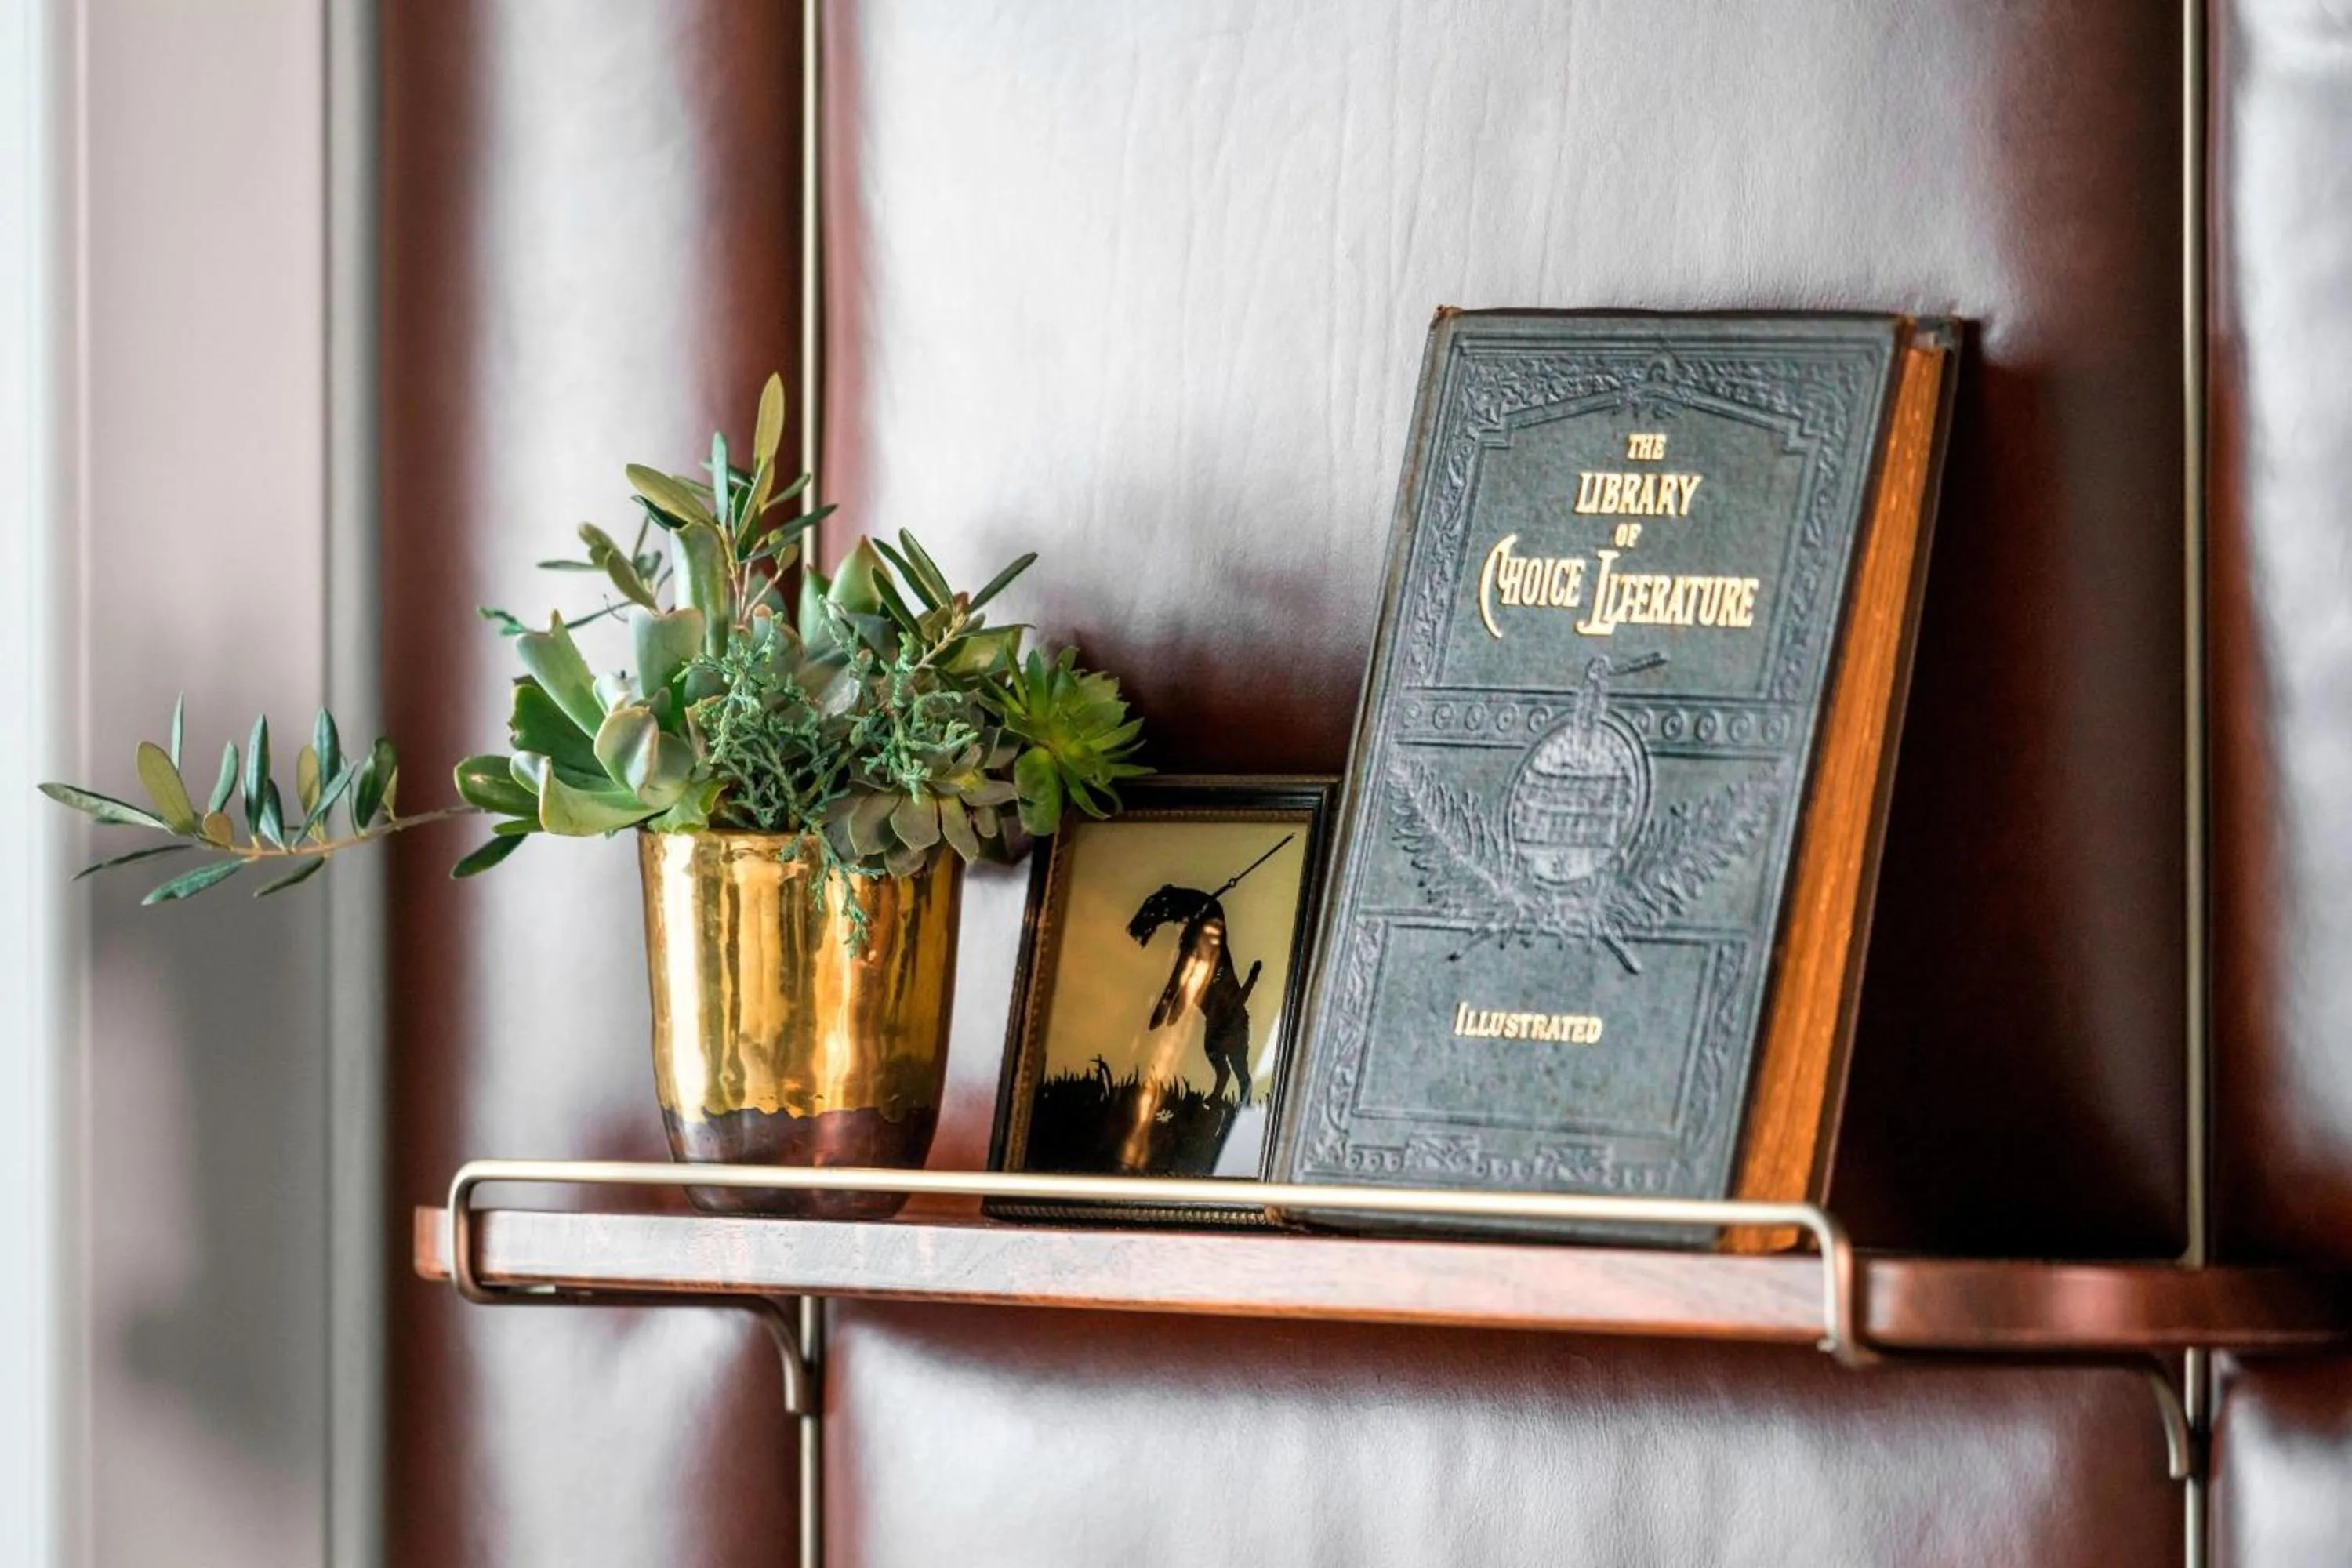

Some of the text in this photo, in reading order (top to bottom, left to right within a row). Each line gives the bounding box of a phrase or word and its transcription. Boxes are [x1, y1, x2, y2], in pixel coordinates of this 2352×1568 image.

[1628, 434, 1667, 460] THE
[1574, 473, 1702, 515] LIBRARY
[1615, 522, 1642, 548] OF
[1479, 533, 1759, 639] CHOICE LITERATURE
[1454, 1001, 1603, 1044] ILLUSTRATED
